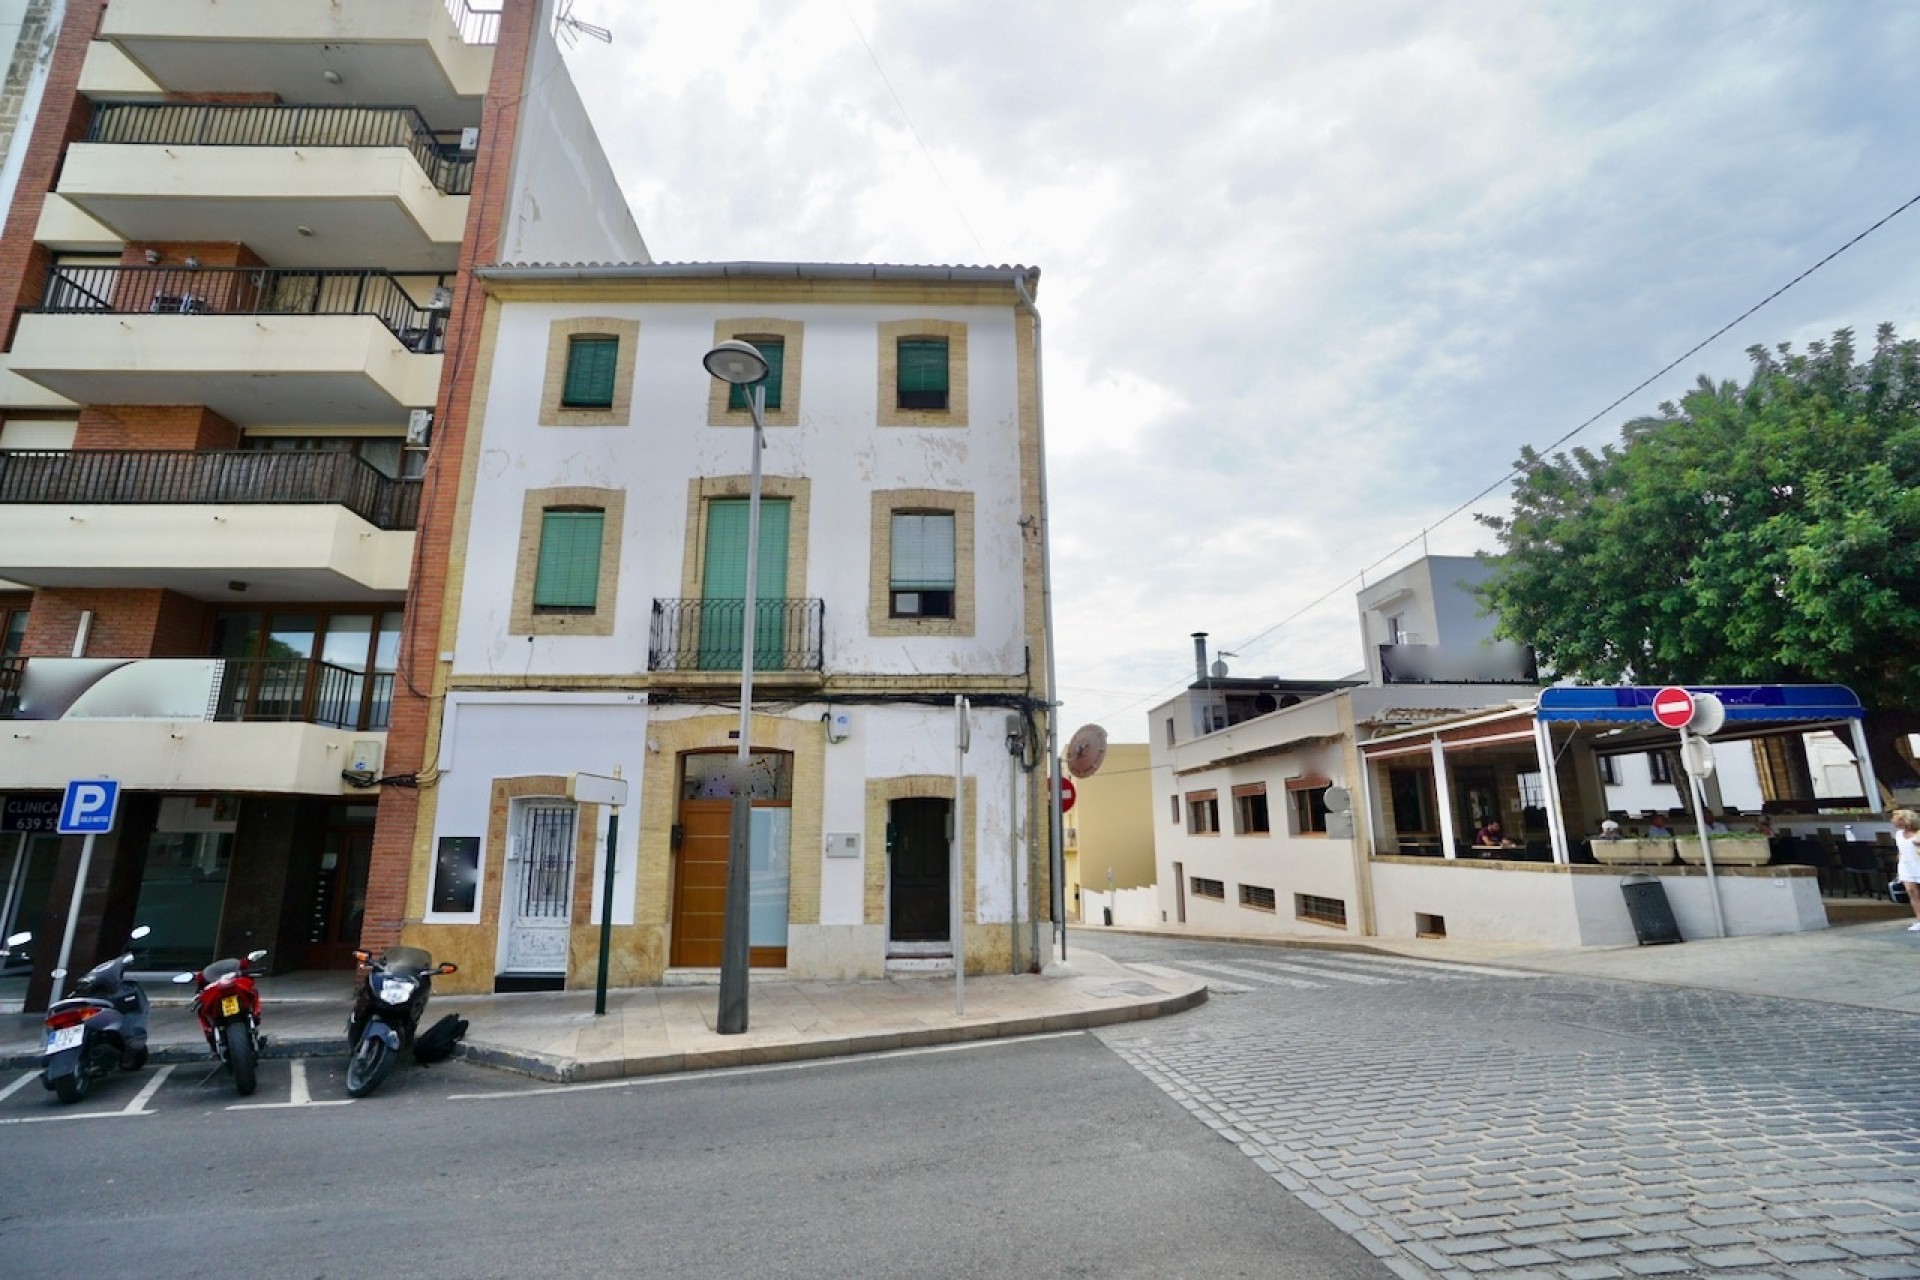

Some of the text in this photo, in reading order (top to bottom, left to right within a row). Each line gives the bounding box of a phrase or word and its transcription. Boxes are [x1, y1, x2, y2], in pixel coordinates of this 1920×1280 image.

[8, 801, 59, 813] CLINICA
[69, 786, 106, 826] P
[17, 817, 41, 829] 639
